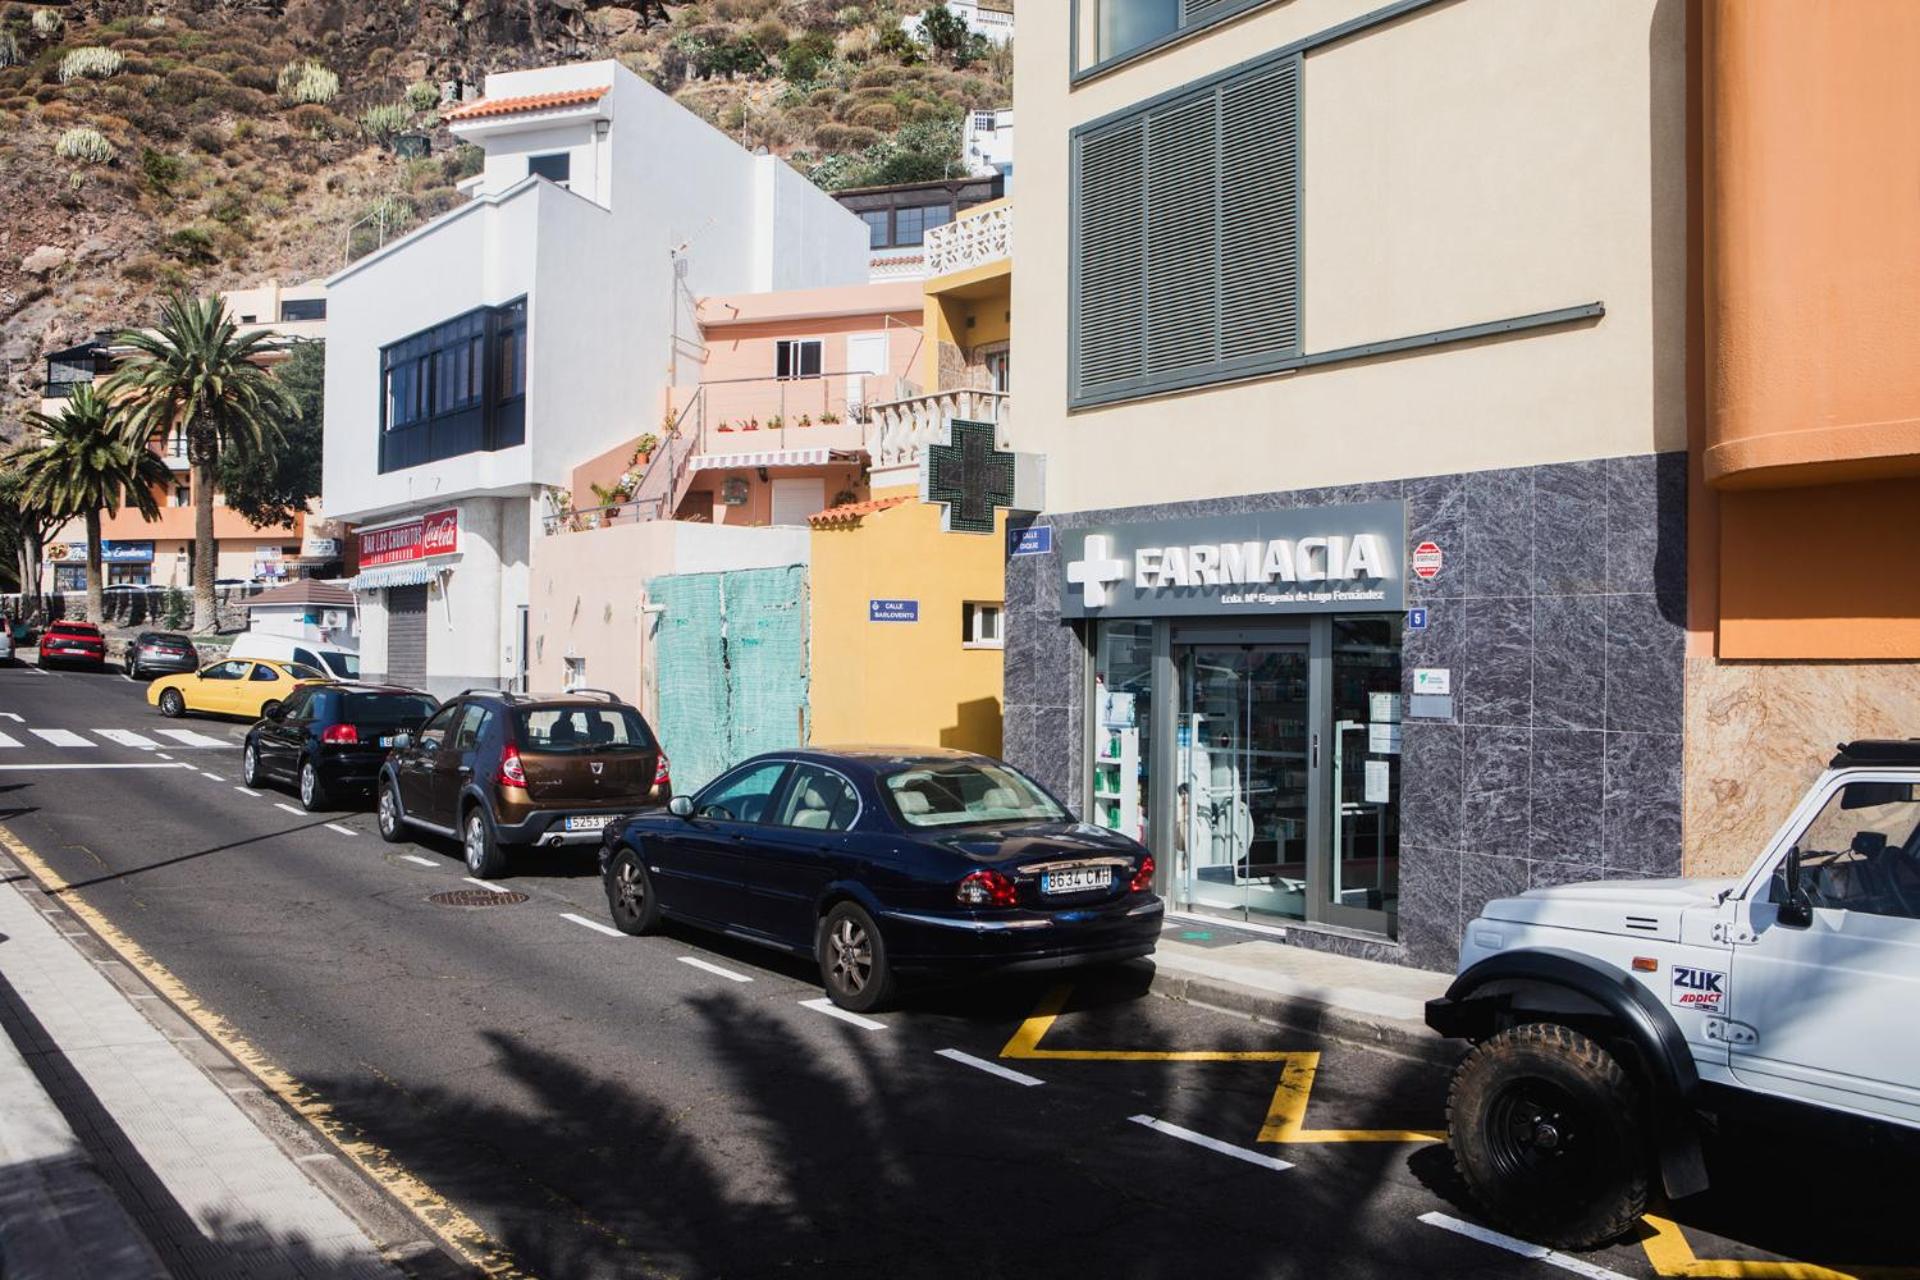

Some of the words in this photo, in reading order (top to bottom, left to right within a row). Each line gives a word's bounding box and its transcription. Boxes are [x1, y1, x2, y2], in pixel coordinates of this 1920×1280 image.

[363, 534, 375, 554] BAR
[375, 530, 387, 552] LOS
[388, 525, 422, 550] CHURRITOS
[1135, 533, 1386, 588] FARMACIA
[1258, 592, 1294, 605] Eugenia
[1295, 591, 1308, 602] de
[1308, 591, 1331, 604] Lugo
[1333, 589, 1385, 601] Fernández
[885, 602, 904, 610] CALLE
[874, 611, 915, 619] BARLOVENTO
[1414, 613, 1421, 624] 5
[572, 816, 600, 828] 5253
[1048, 871, 1080, 888] 8634
[1674, 968, 1722, 993] ZUK
[1680, 993, 1721, 1003] ADDICT
